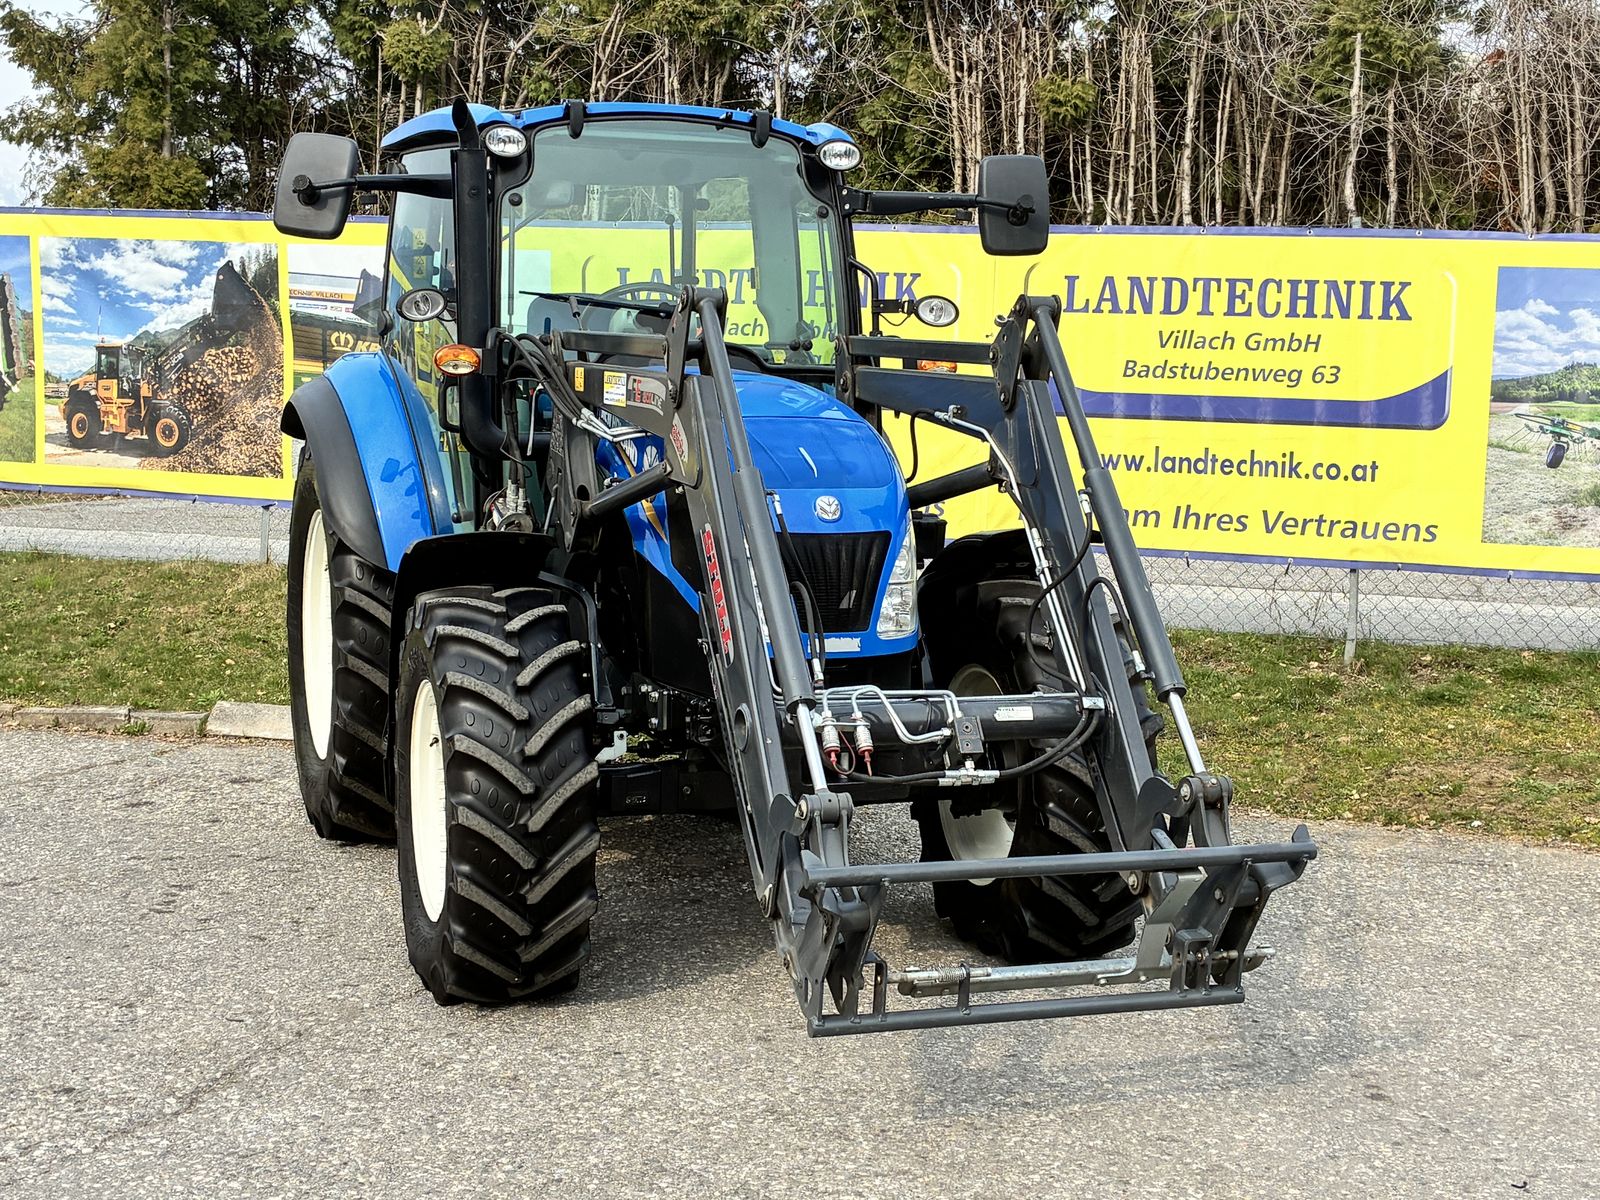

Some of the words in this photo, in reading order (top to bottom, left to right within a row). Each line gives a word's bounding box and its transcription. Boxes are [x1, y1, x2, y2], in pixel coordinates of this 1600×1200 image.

[1064, 276, 1412, 320] LANDTECHNIK
[1158, 330, 1236, 351] Villach
[1244, 333, 1322, 353] GmbH
[1122, 359, 1303, 388] Badstubenweg
[1311, 366, 1341, 384] 63
[1172, 504, 1249, 533] Ihres
[1262, 510, 1439, 543] Vertrauens
[702, 529, 733, 655] STOLL
